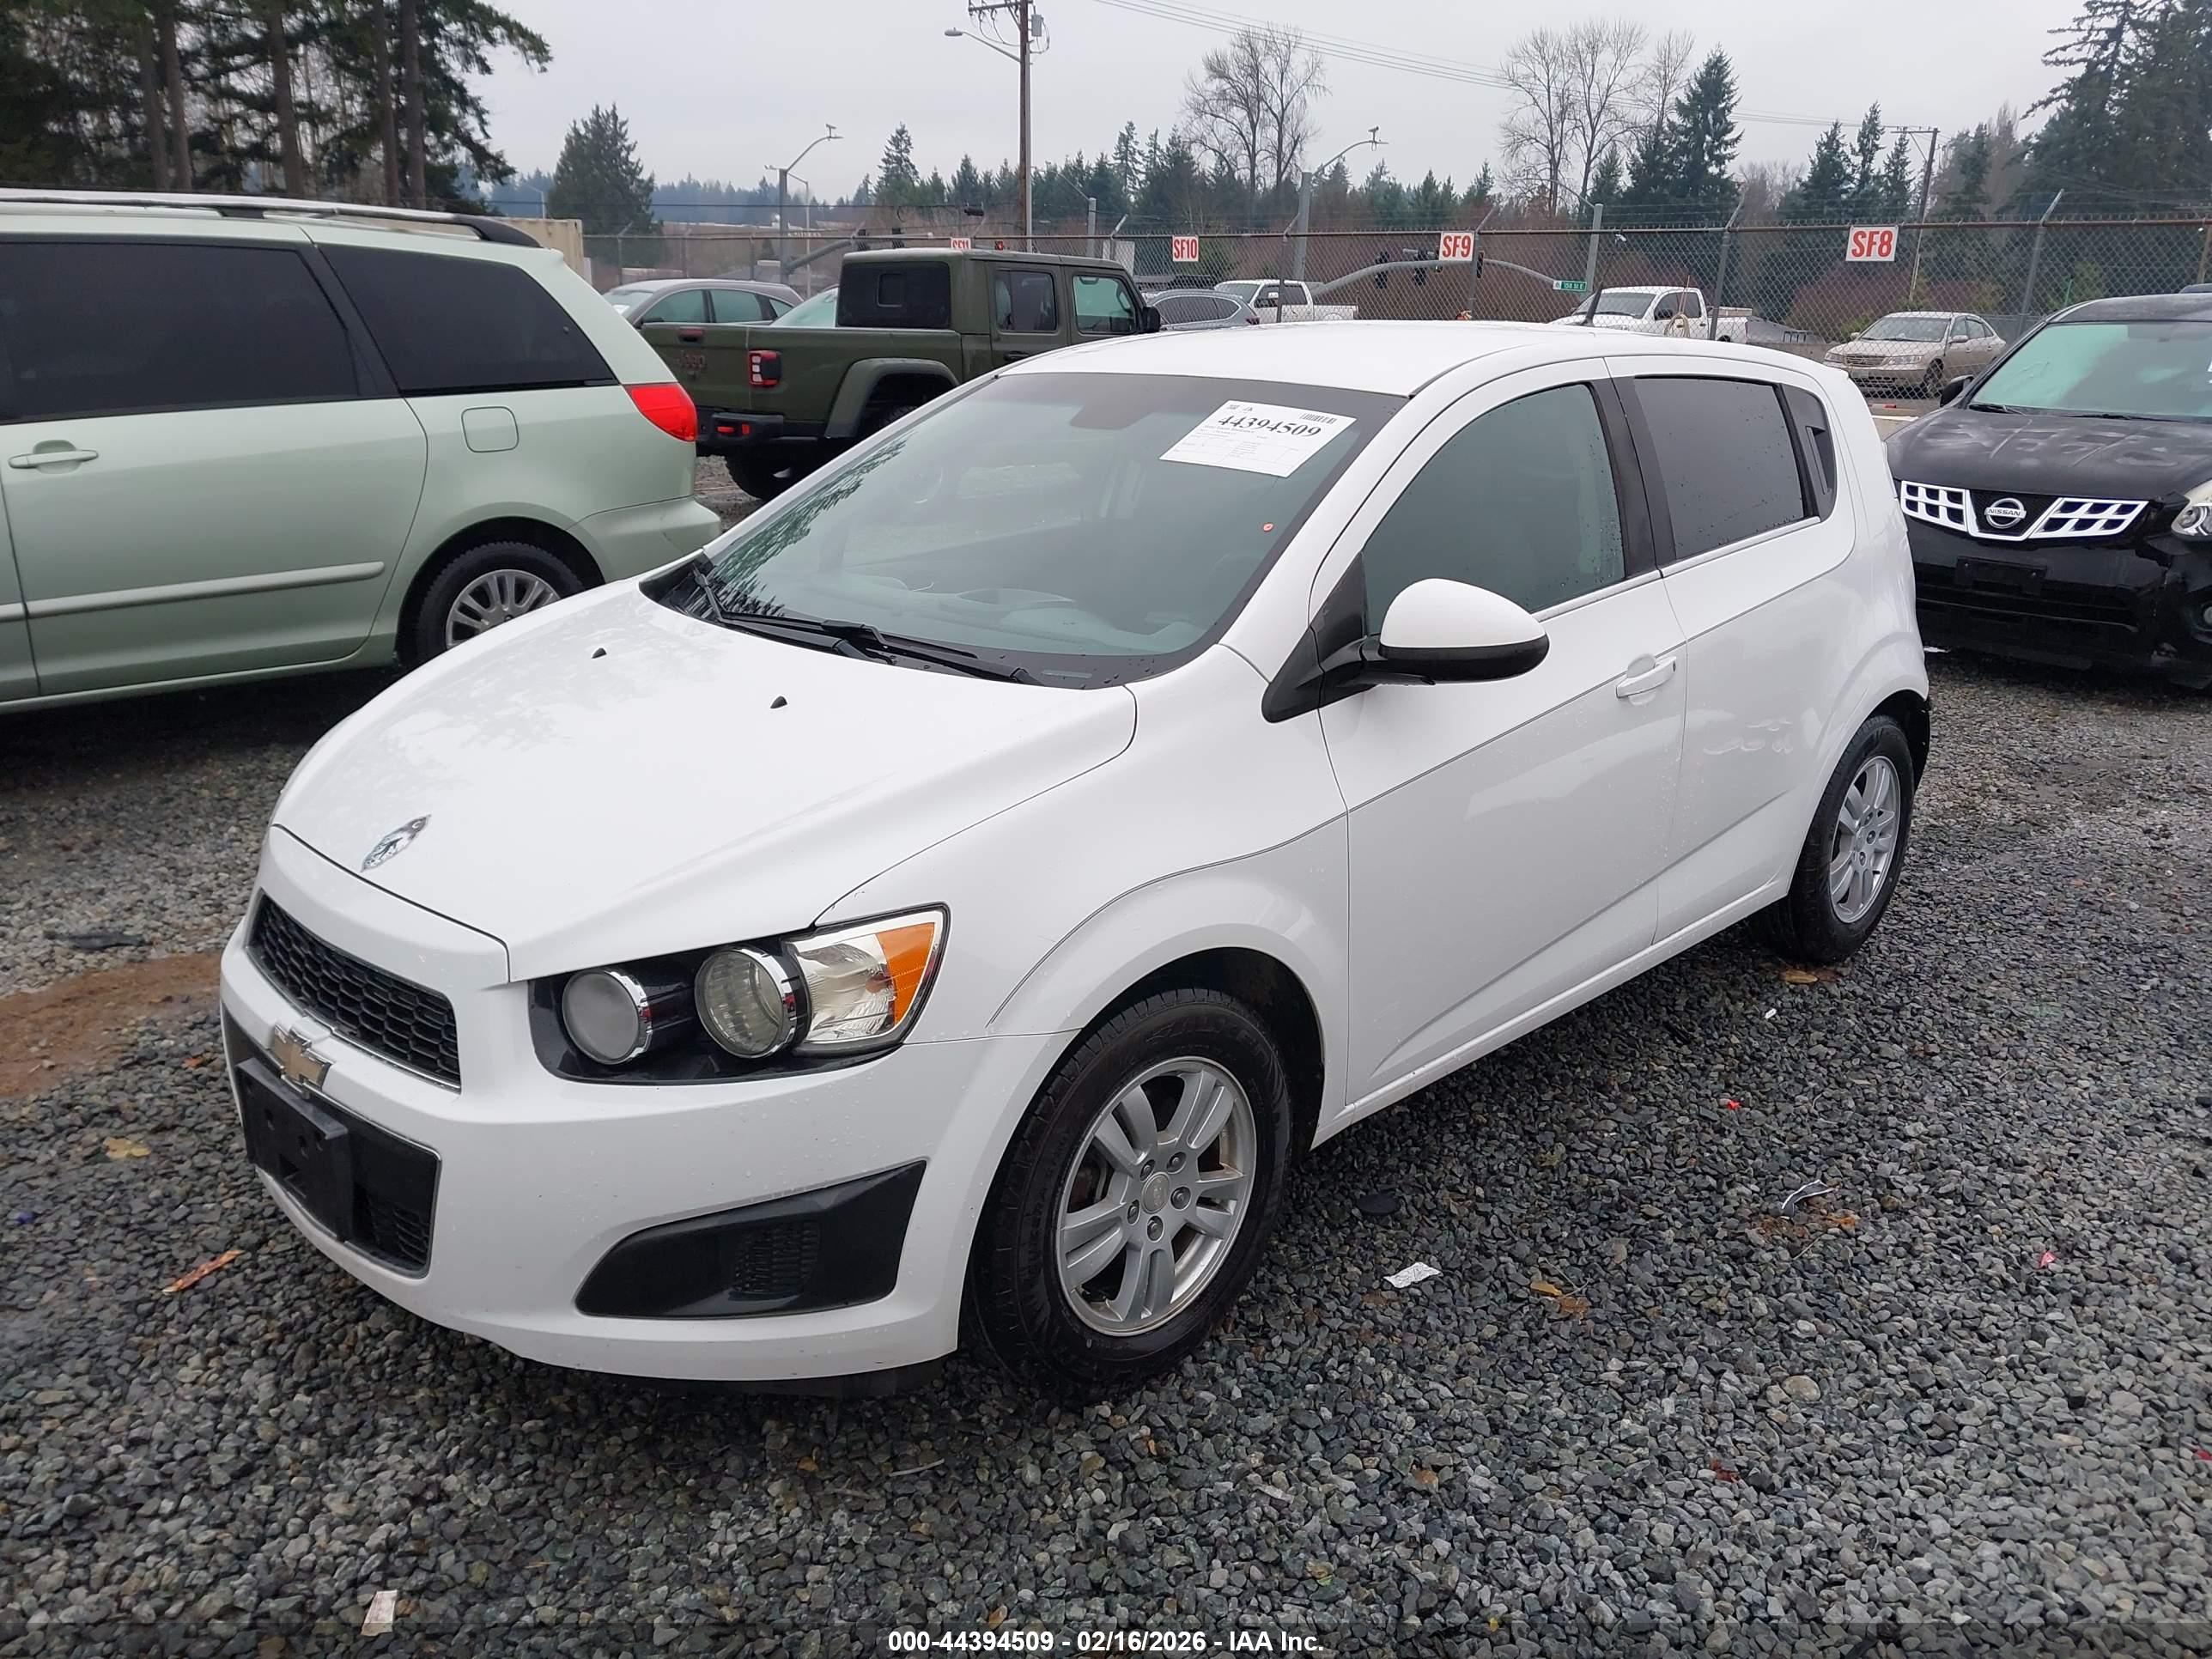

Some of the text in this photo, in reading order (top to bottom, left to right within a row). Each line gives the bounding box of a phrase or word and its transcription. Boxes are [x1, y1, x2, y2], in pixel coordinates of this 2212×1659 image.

[1174, 239, 1197, 258] SF10
[1443, 234, 1471, 258] SF9
[1851, 230, 1893, 257] SF8
[1218, 415, 1322, 437] 44394509
